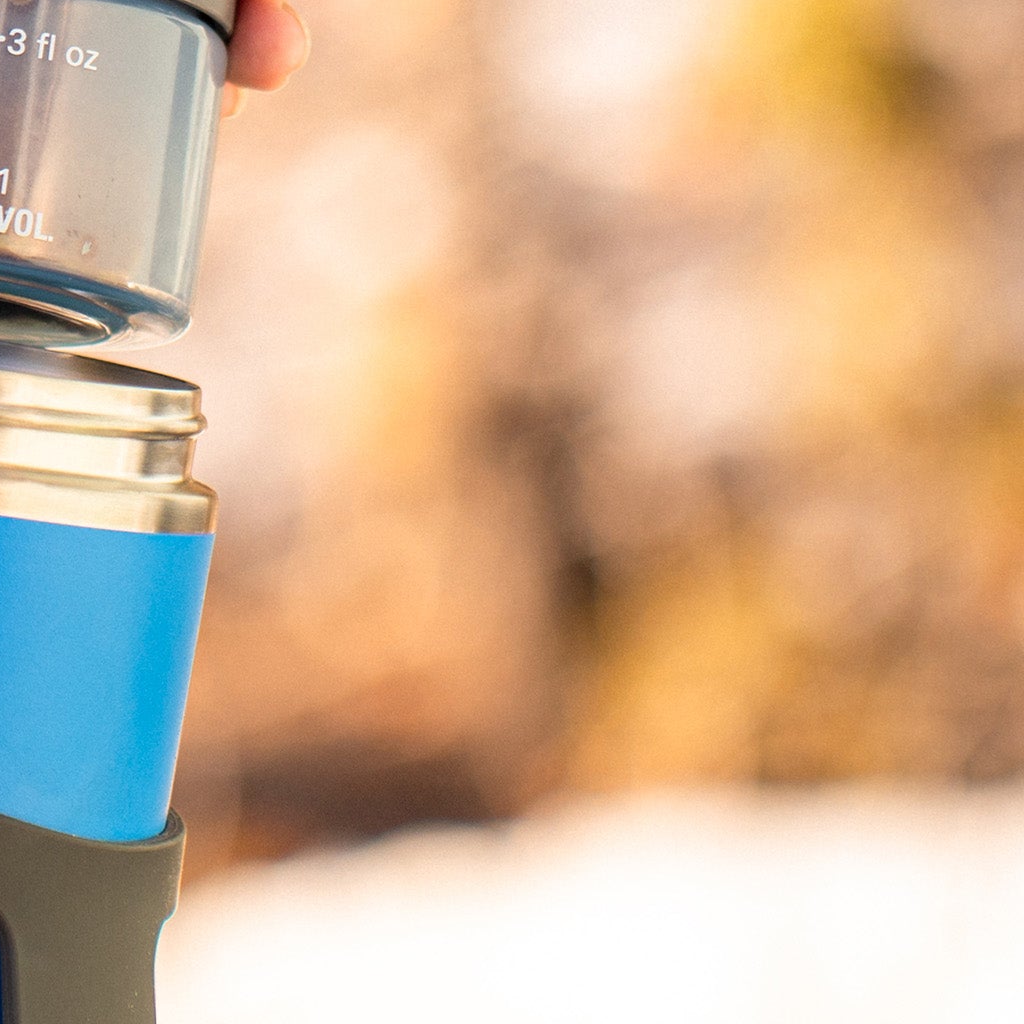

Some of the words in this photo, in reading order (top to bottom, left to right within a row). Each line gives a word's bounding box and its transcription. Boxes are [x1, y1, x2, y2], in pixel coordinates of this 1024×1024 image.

[6, 28, 27, 56] 3
[37, 32, 56, 61] fl
[65, 46, 100, 71] oz
